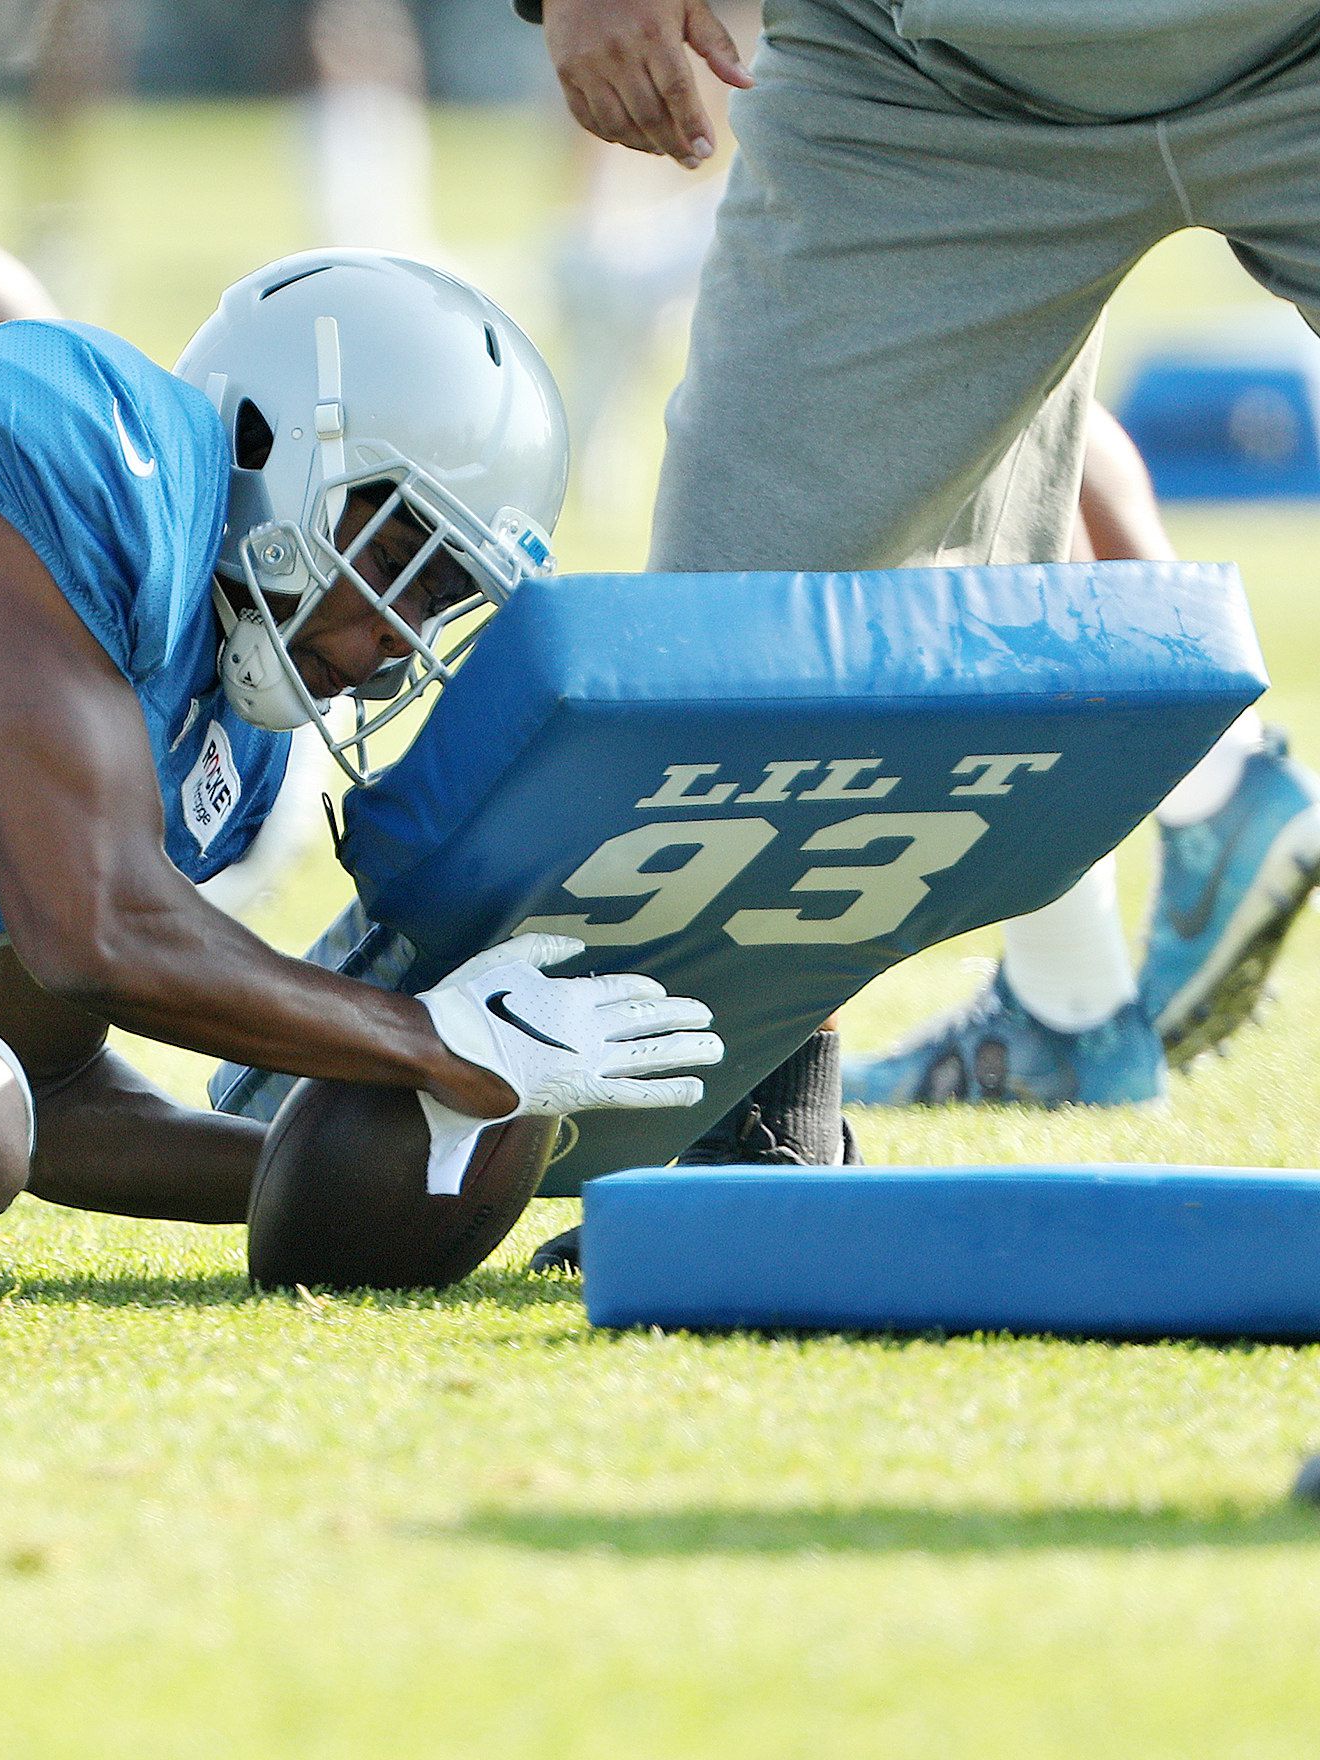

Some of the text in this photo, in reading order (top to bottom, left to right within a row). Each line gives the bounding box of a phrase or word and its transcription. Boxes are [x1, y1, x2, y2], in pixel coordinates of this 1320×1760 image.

[202, 739, 231, 820] ROCKET
[634, 752, 1063, 809] LIL T
[512, 810, 991, 946] 93
